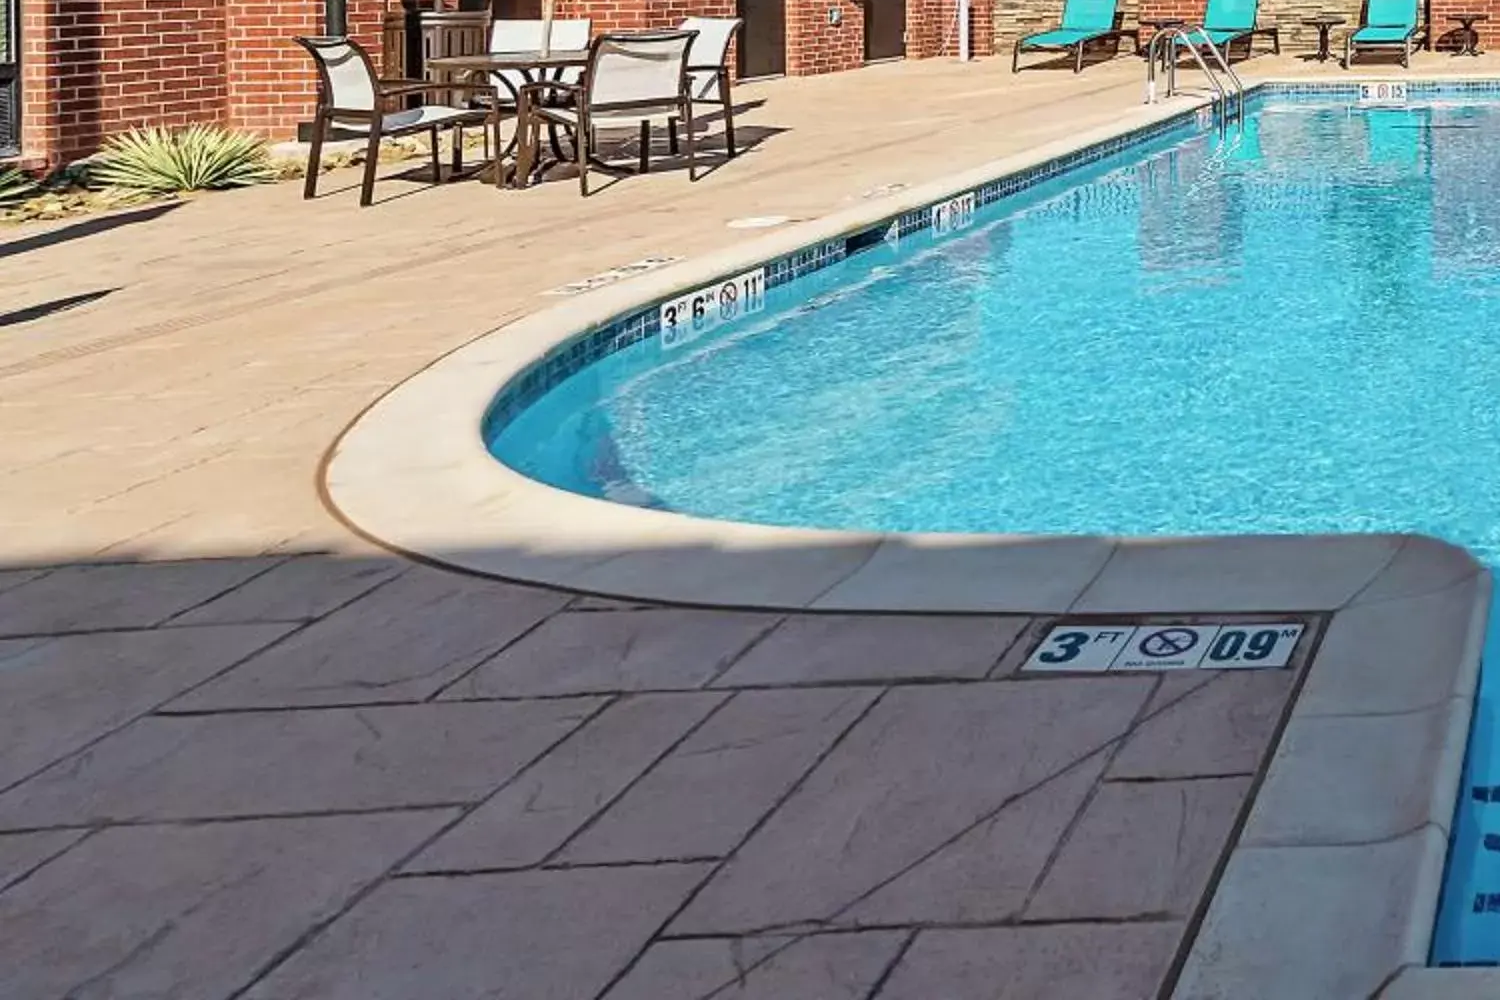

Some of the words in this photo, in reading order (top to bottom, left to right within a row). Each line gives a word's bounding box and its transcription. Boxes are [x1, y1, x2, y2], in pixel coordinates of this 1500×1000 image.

[664, 306, 677, 328] 3
[692, 296, 705, 320] 6
[1039, 631, 1091, 664] 3
[1093, 630, 1125, 643] FT
[1281, 628, 1300, 638] M
